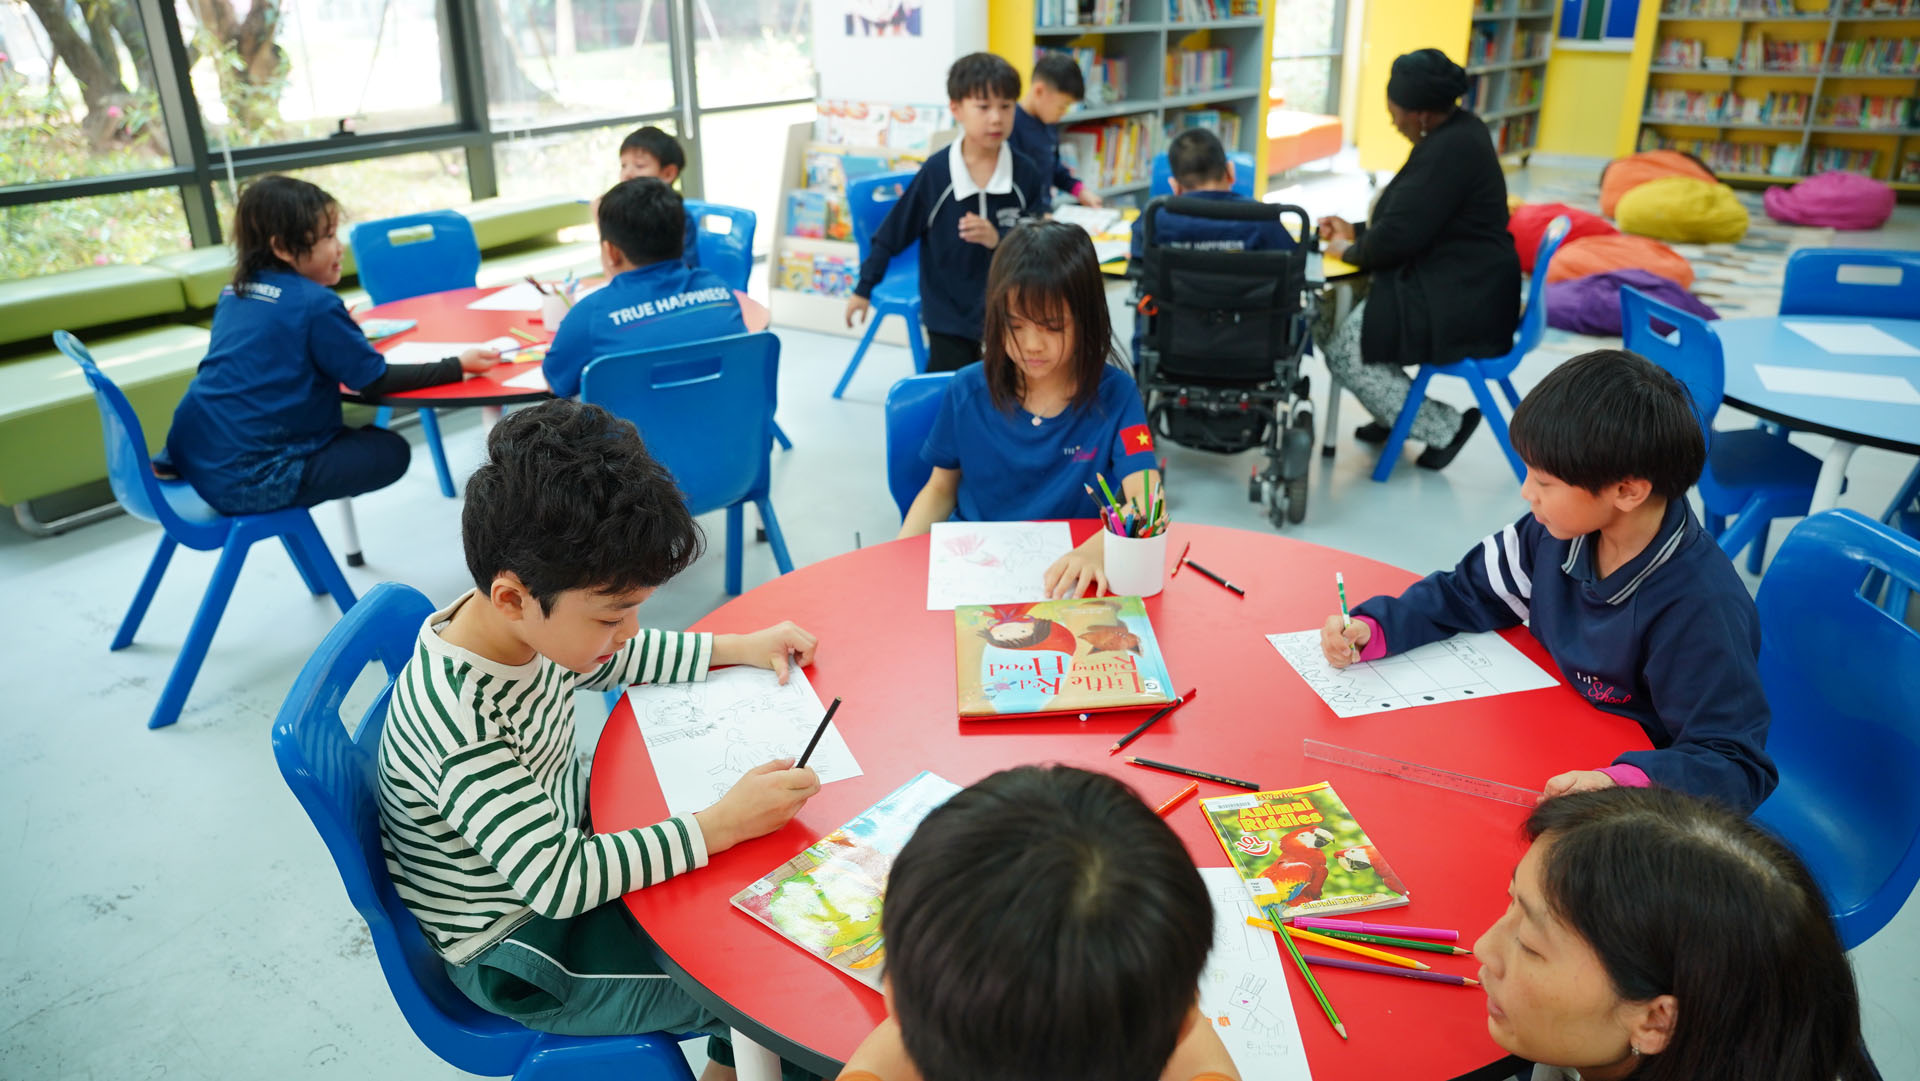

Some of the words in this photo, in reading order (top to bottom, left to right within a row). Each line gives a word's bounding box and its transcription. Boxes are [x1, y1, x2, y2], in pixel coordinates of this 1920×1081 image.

[608, 301, 656, 326] TRUE
[655, 286, 731, 313] HAPPINESS
[989, 655, 1065, 677] Hood
[1072, 655, 1137, 672] Riding
[1019, 677, 1061, 696] Red
[1071, 671, 1145, 694] Little
[1587, 681, 1632, 704] School
[1239, 797, 1315, 819] Animal
[1239, 812, 1324, 832] Riddles
[1236, 836, 1266, 850] LOL
